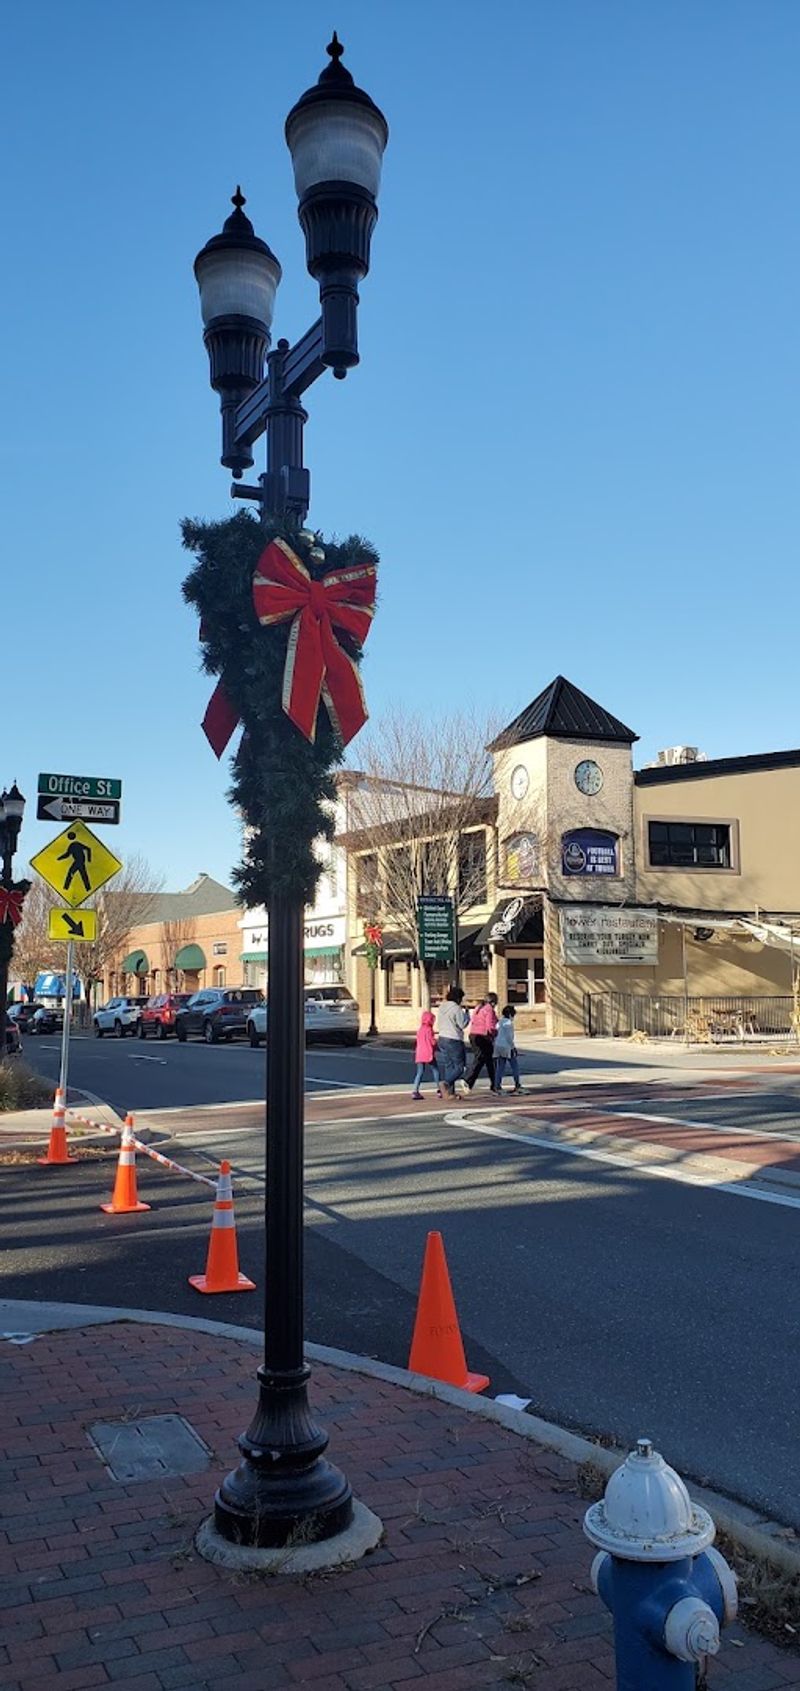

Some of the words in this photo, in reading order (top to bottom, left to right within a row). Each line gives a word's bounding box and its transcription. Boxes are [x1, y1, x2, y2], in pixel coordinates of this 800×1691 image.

[48, 776, 90, 794] Office
[96, 780, 112, 796] St
[61, 803, 82, 816] ONE
[88, 806, 111, 816] WAY
[587, 847, 614, 856] FOOTBALL
[303, 923, 335, 939] RUGS
